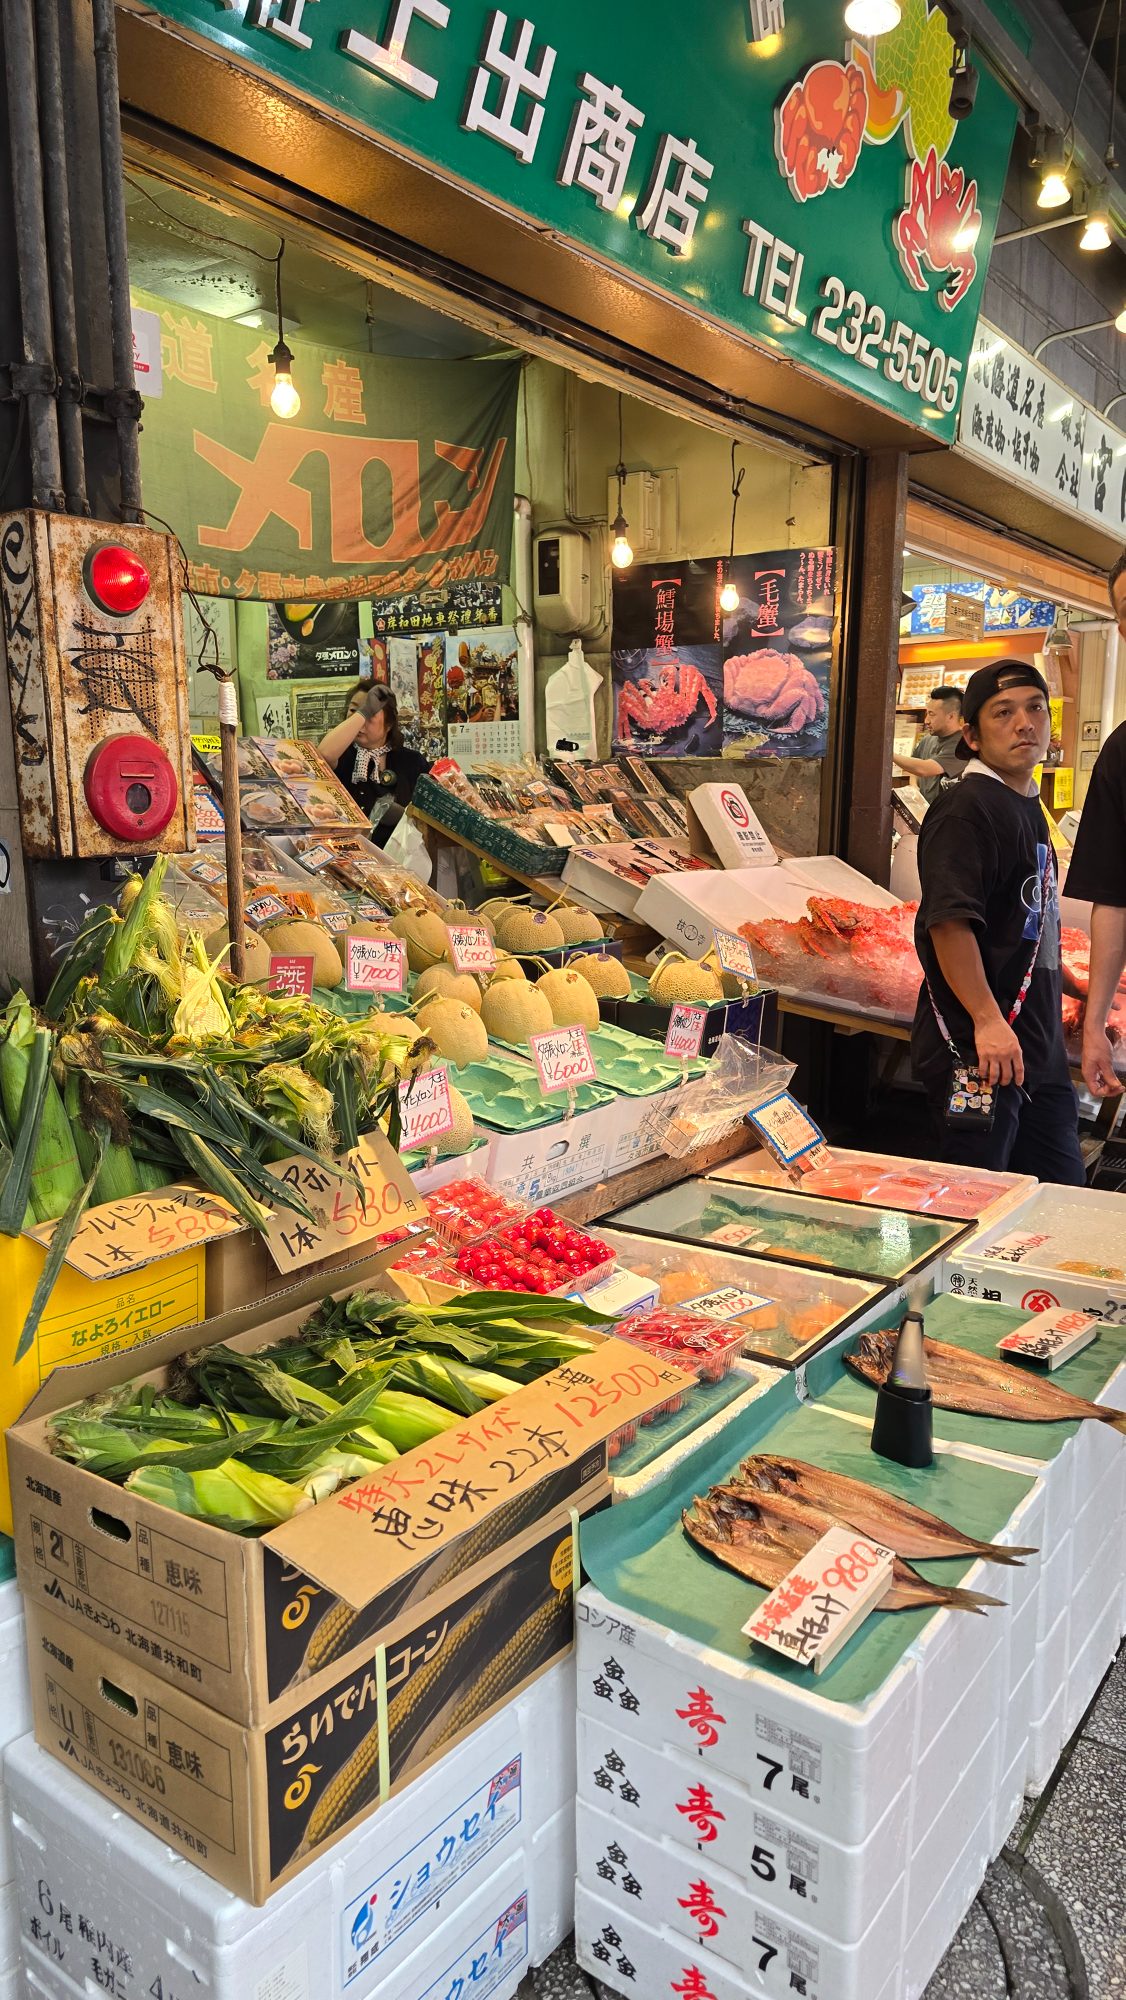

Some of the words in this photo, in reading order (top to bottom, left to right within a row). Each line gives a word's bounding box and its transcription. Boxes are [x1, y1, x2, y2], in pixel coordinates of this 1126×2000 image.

[743, 219, 806, 328] TEL
[811, 276, 962, 413] 232-5505
[193, 422, 507, 563] メロン
[315, 650, 351, 661] 夕張メロン
[459, 725, 464, 733] 7
[351, 944, 385, 960] 夕張メロン
[277, 969, 306, 984] アサヒ
[538, 1040, 572, 1063] 夕張メロン
[48, 1193, 217, 1241] ールドラッシュ
[84, 1243, 143, 1268] 1本
[280, 1222, 322, 1257] 1本
[116, 1294, 136, 1309] 品名
[71, 1297, 176, 1347] なよろイエロー
[25, 1476, 62, 1506] 北海道産
[372, 1479, 498, 1550] 恵味
[490, 1424, 570, 1483] 22本
[31, 1520, 45, 1562] 規格
[50, 1531, 70, 1568] 2L
[138, 1527, 151, 1574] 品種
[164, 1559, 203, 1596] 恵味
[67, 1592, 121, 1636] JAきょうわ
[125, 1628, 203, 1683] 北海道共和町
[150, 1599, 191, 1638] 127115
[42, 1637, 75, 1673] 北海道産
[282, 1620, 449, 1766] らいでんコーン
[146, 1705, 158, 1749] 品種
[166, 1741, 205, 1780] 恵味
[136, 1796, 208, 1859] 北海道共和町
[389, 1789, 500, 1910] ショウセイ
